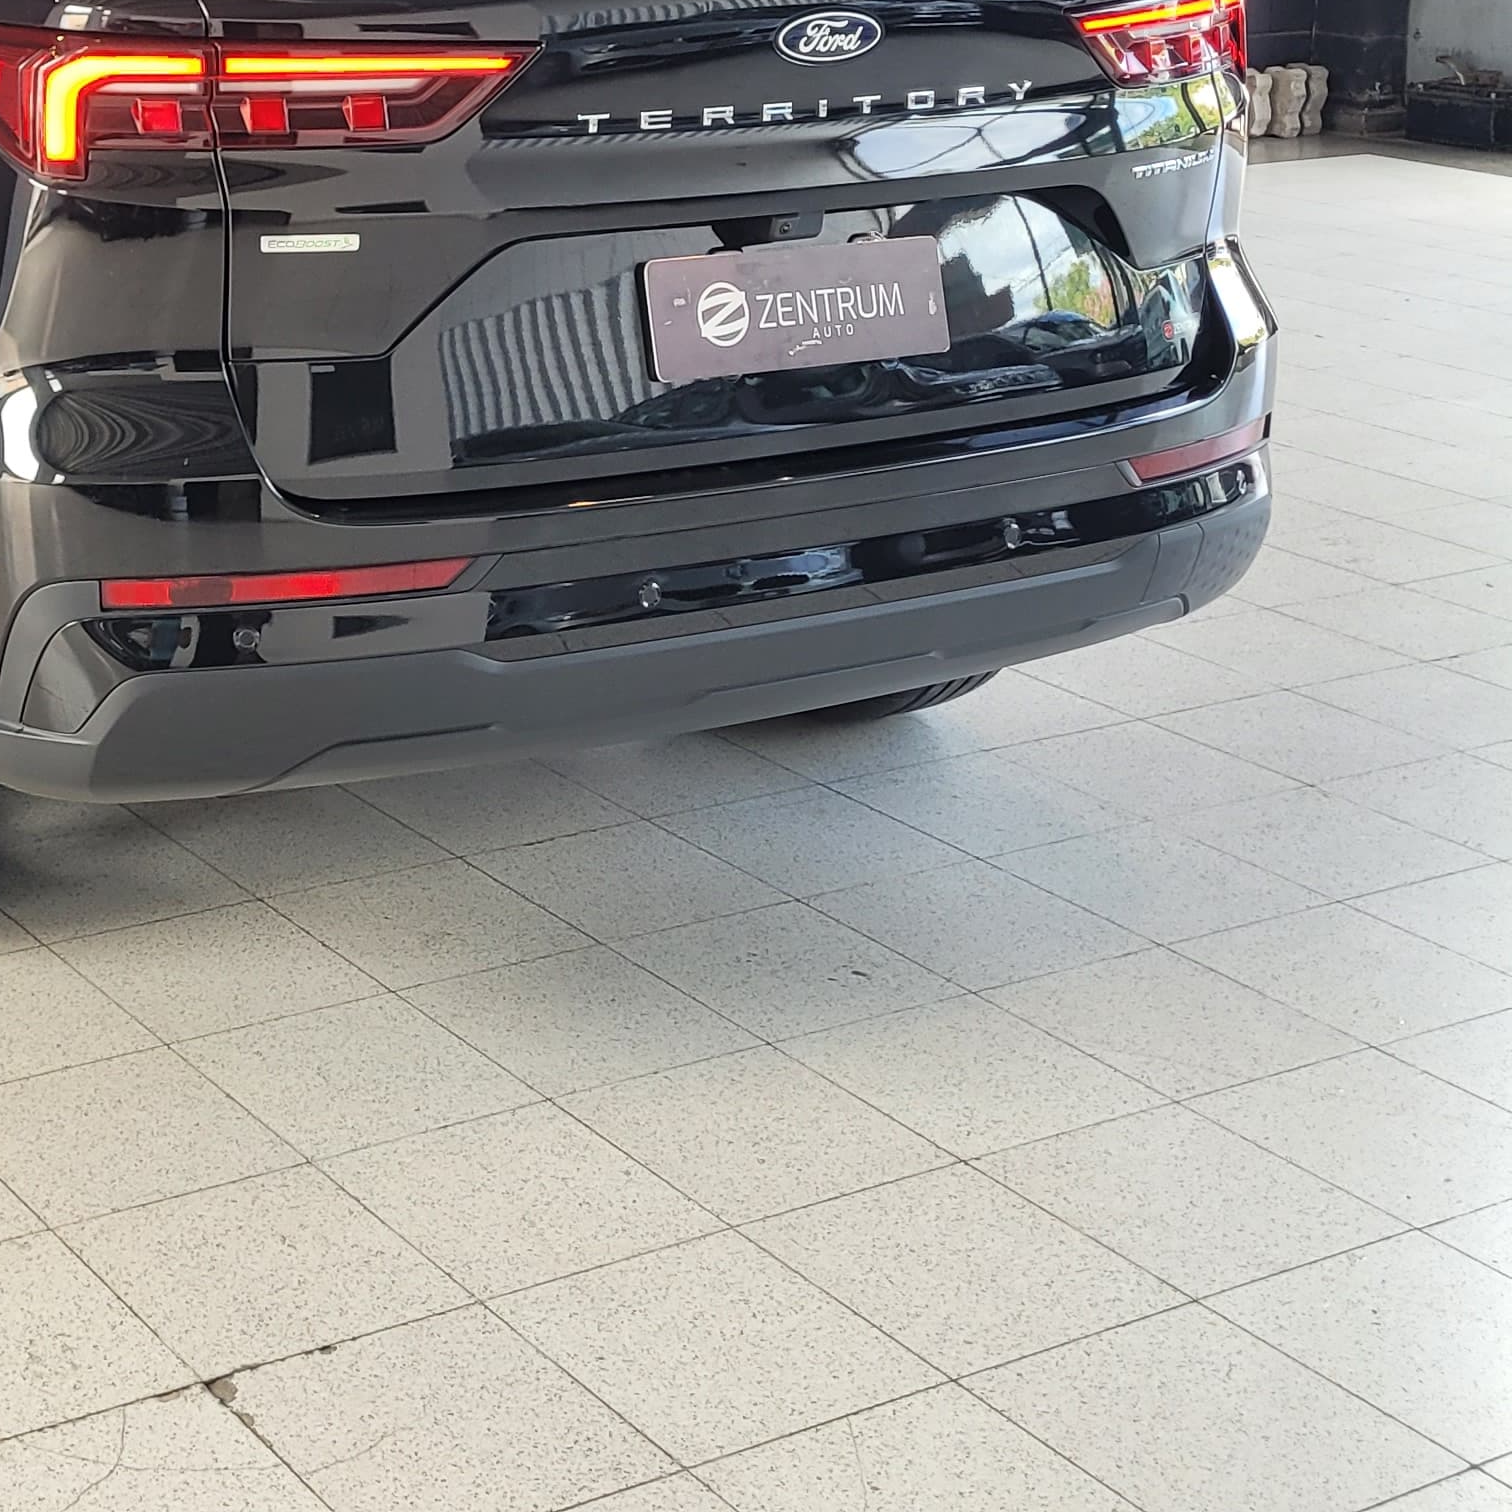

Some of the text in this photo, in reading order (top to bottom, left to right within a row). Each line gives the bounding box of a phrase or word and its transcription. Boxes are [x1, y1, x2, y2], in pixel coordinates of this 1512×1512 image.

[798, 19, 863, 53] Ford
[577, 79, 1034, 135] TERRITORY
[755, 282, 906, 329] ZENTRUM
[812, 323, 856, 339] AUTO
